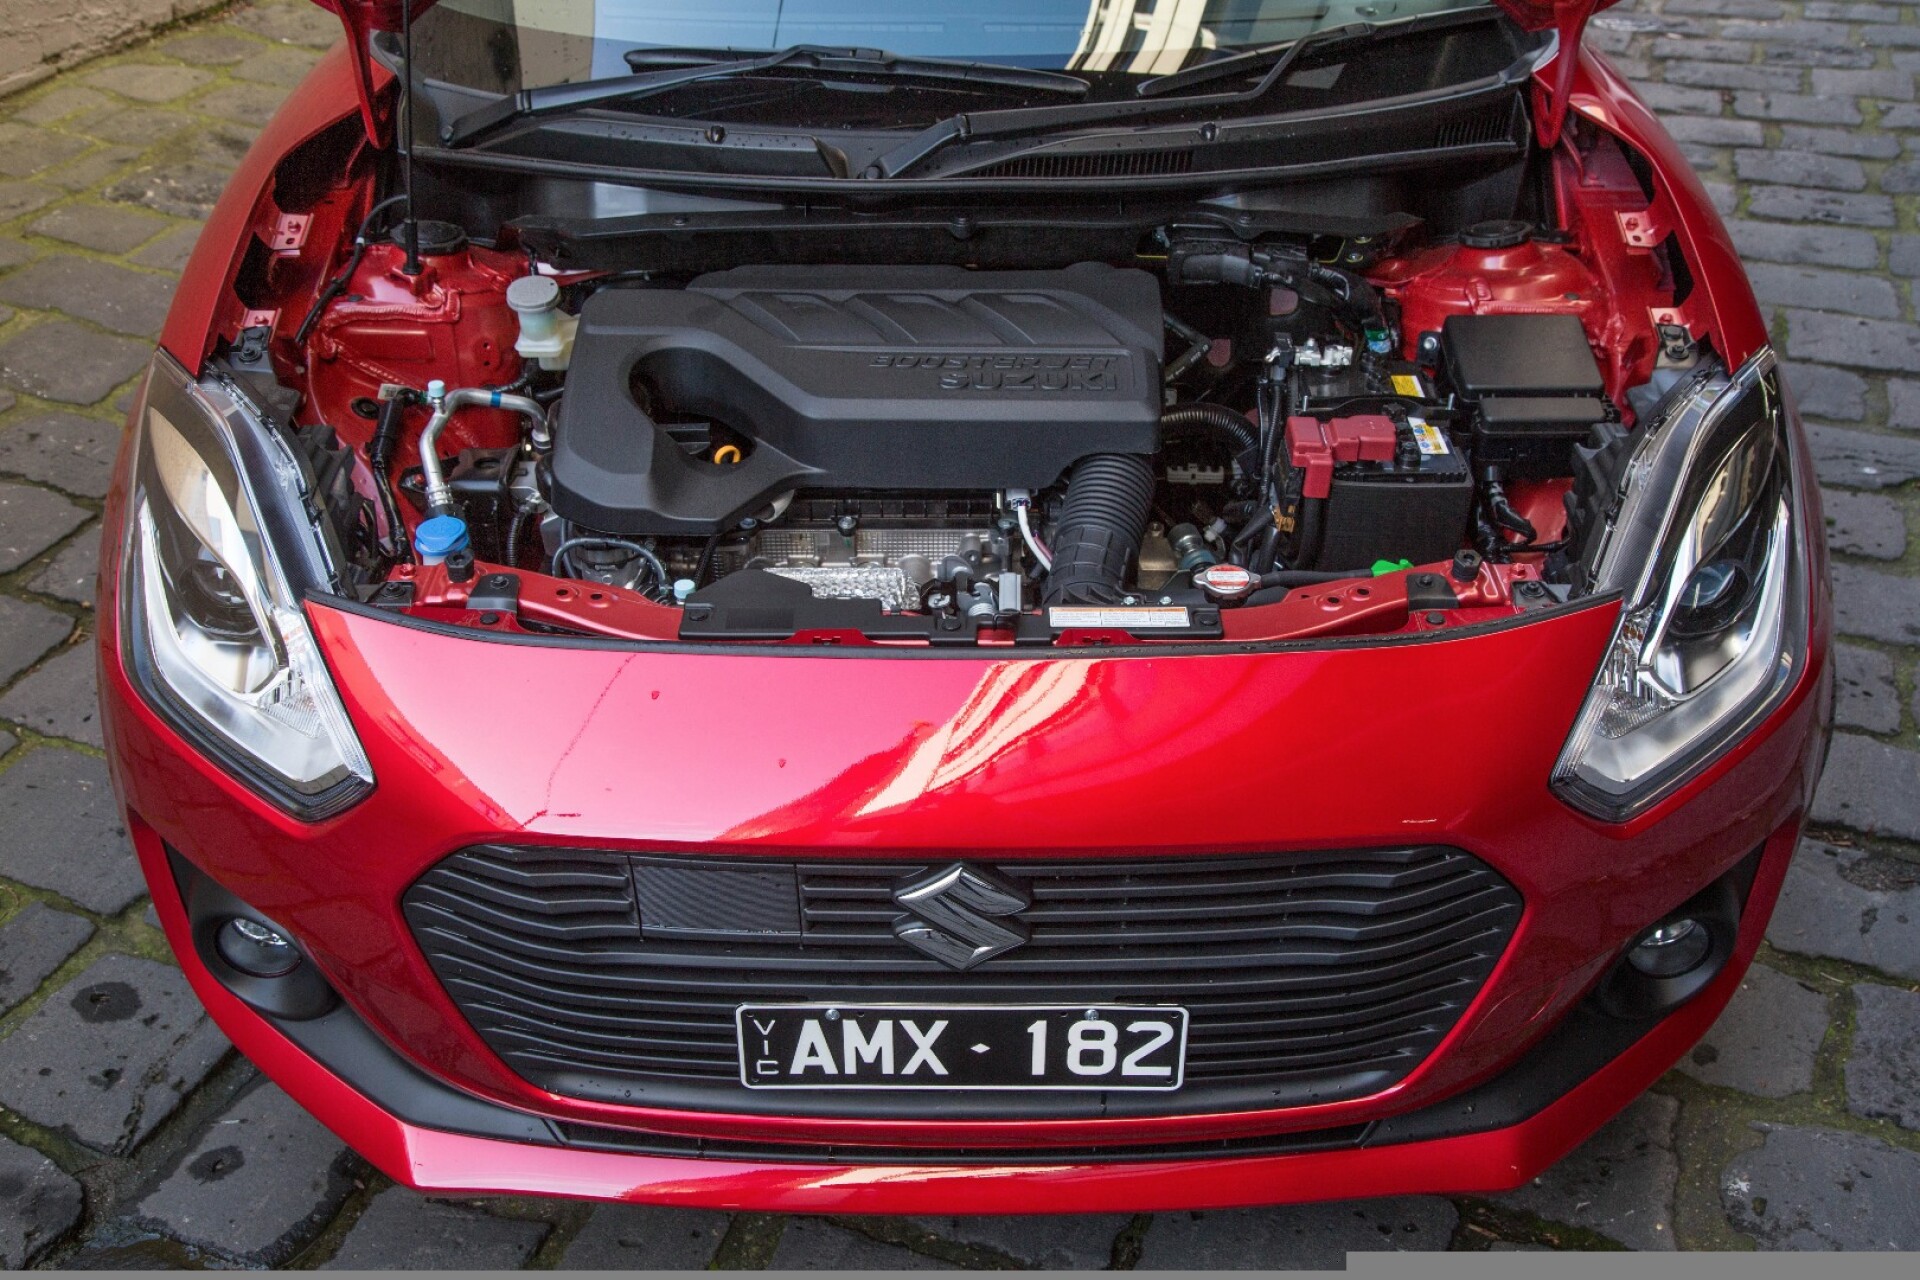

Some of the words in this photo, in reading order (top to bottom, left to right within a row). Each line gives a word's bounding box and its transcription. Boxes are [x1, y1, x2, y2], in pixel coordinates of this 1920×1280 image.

[868, 355, 1119, 369] BOOSTERJET
[939, 372, 1118, 391] SUZUKI
[753, 1018, 780, 1076] VIC
[789, 1019, 950, 1076] AMX
[1026, 1019, 1176, 1077] 182
